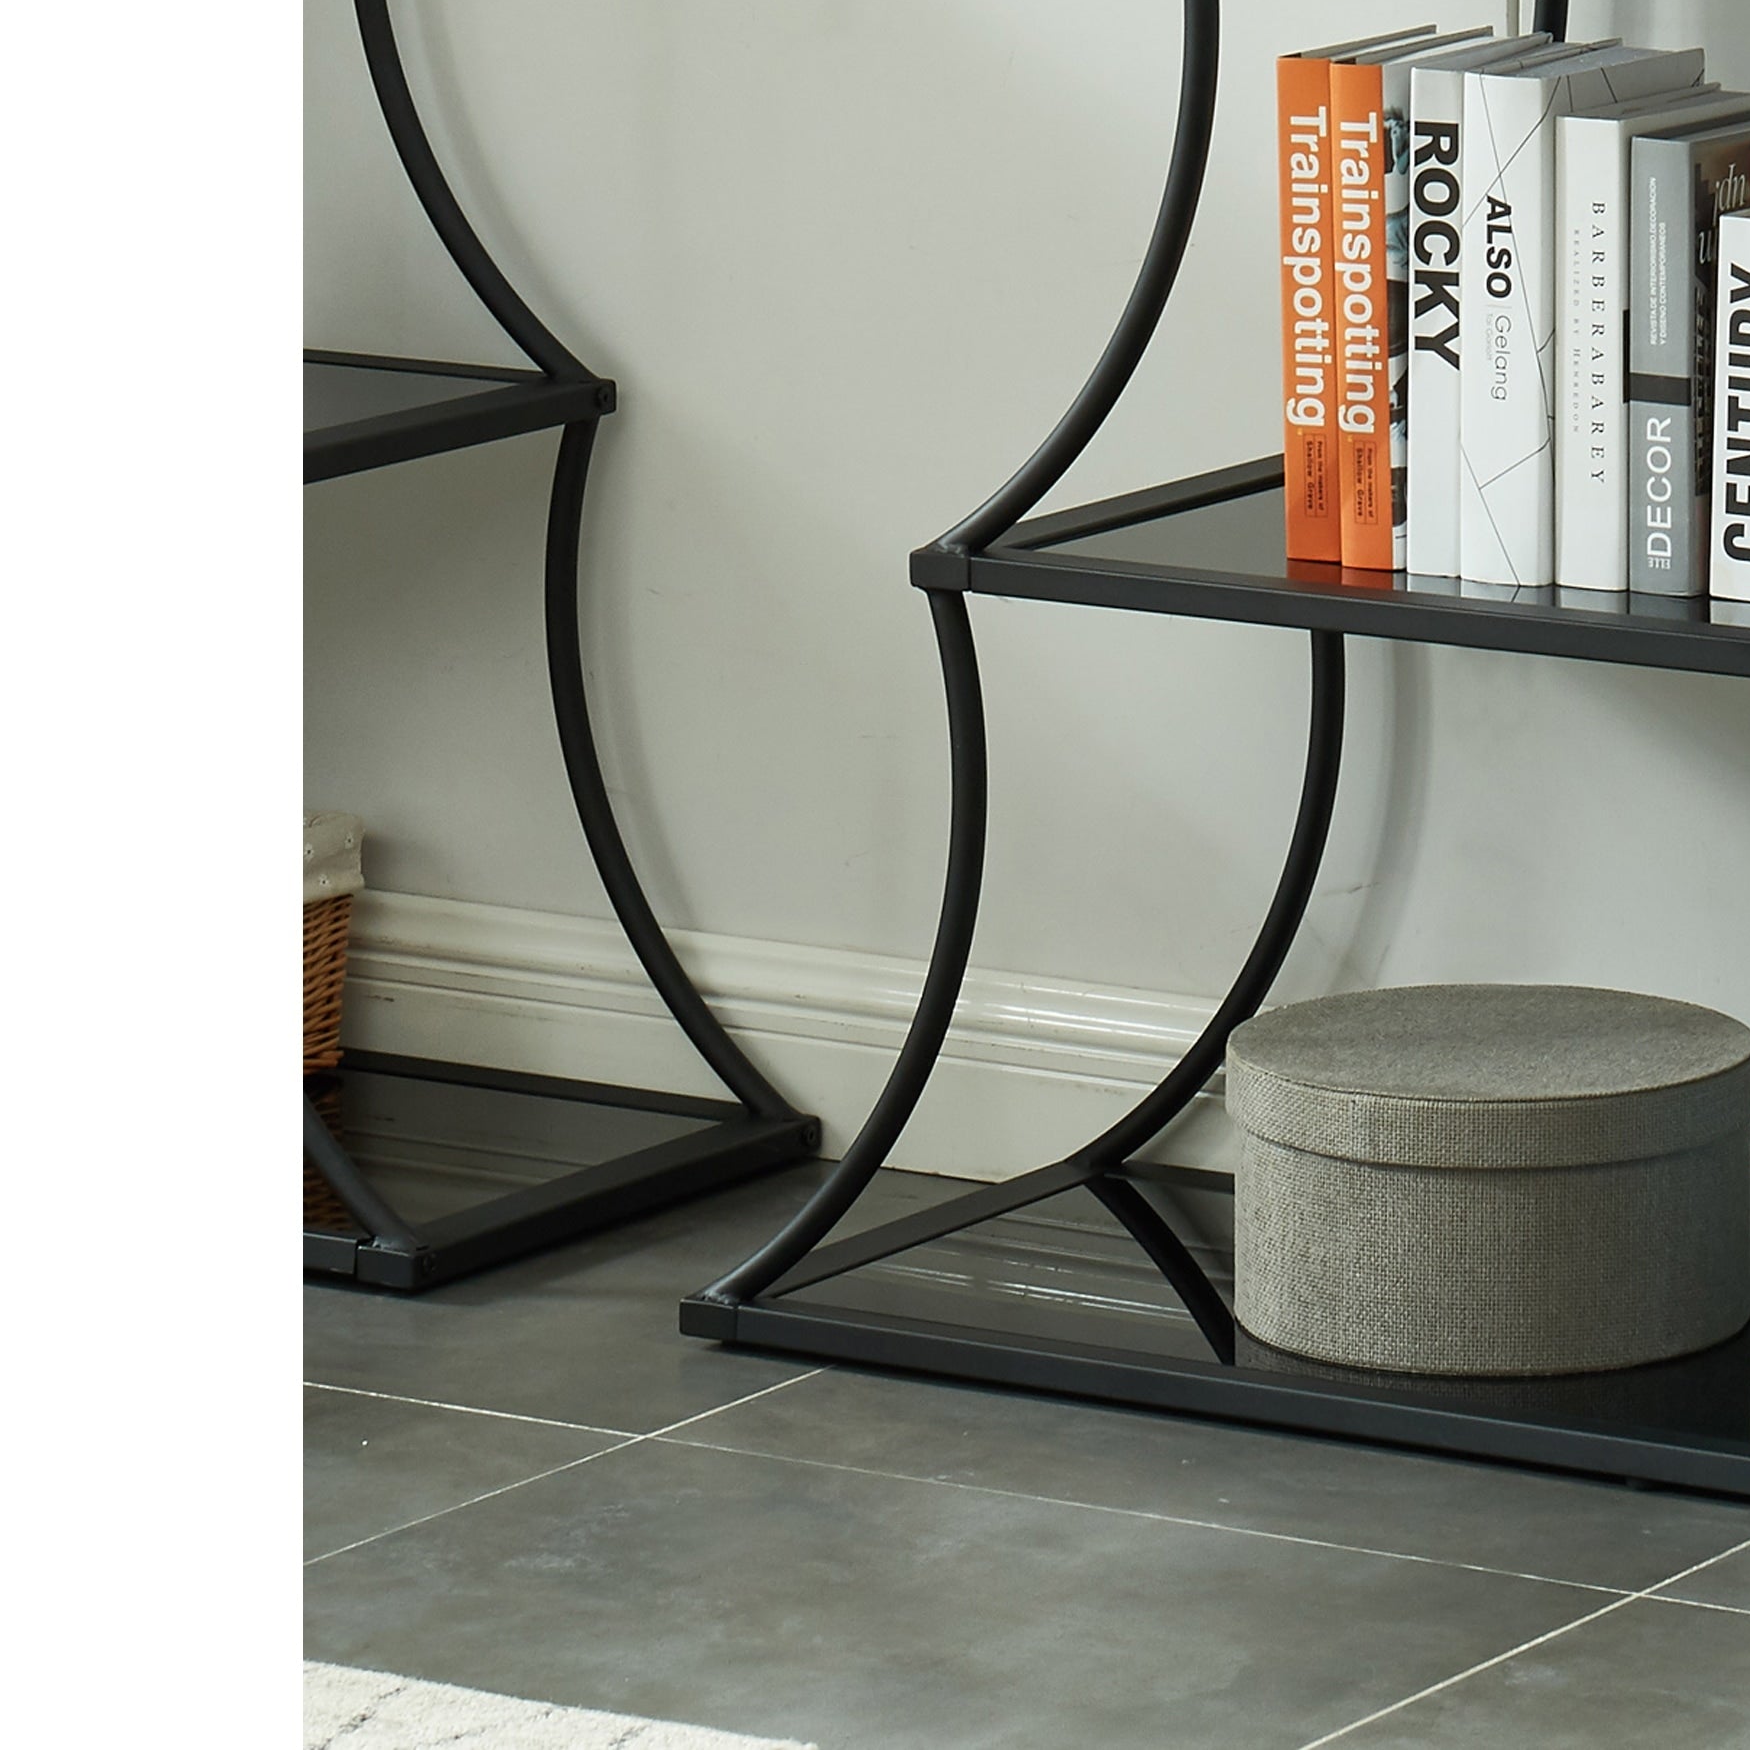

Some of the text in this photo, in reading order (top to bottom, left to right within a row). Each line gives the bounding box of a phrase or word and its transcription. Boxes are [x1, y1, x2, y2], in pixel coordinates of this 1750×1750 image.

[1283, 106, 1332, 428] Trainspotting
[1334, 112, 1383, 435] Trainspotting
[1413, 120, 1461, 371] ROCKY
[1486, 195, 1513, 299] ALSO
[1490, 314, 1512, 401] Gelang
[1646, 417, 1672, 556] DECOR
